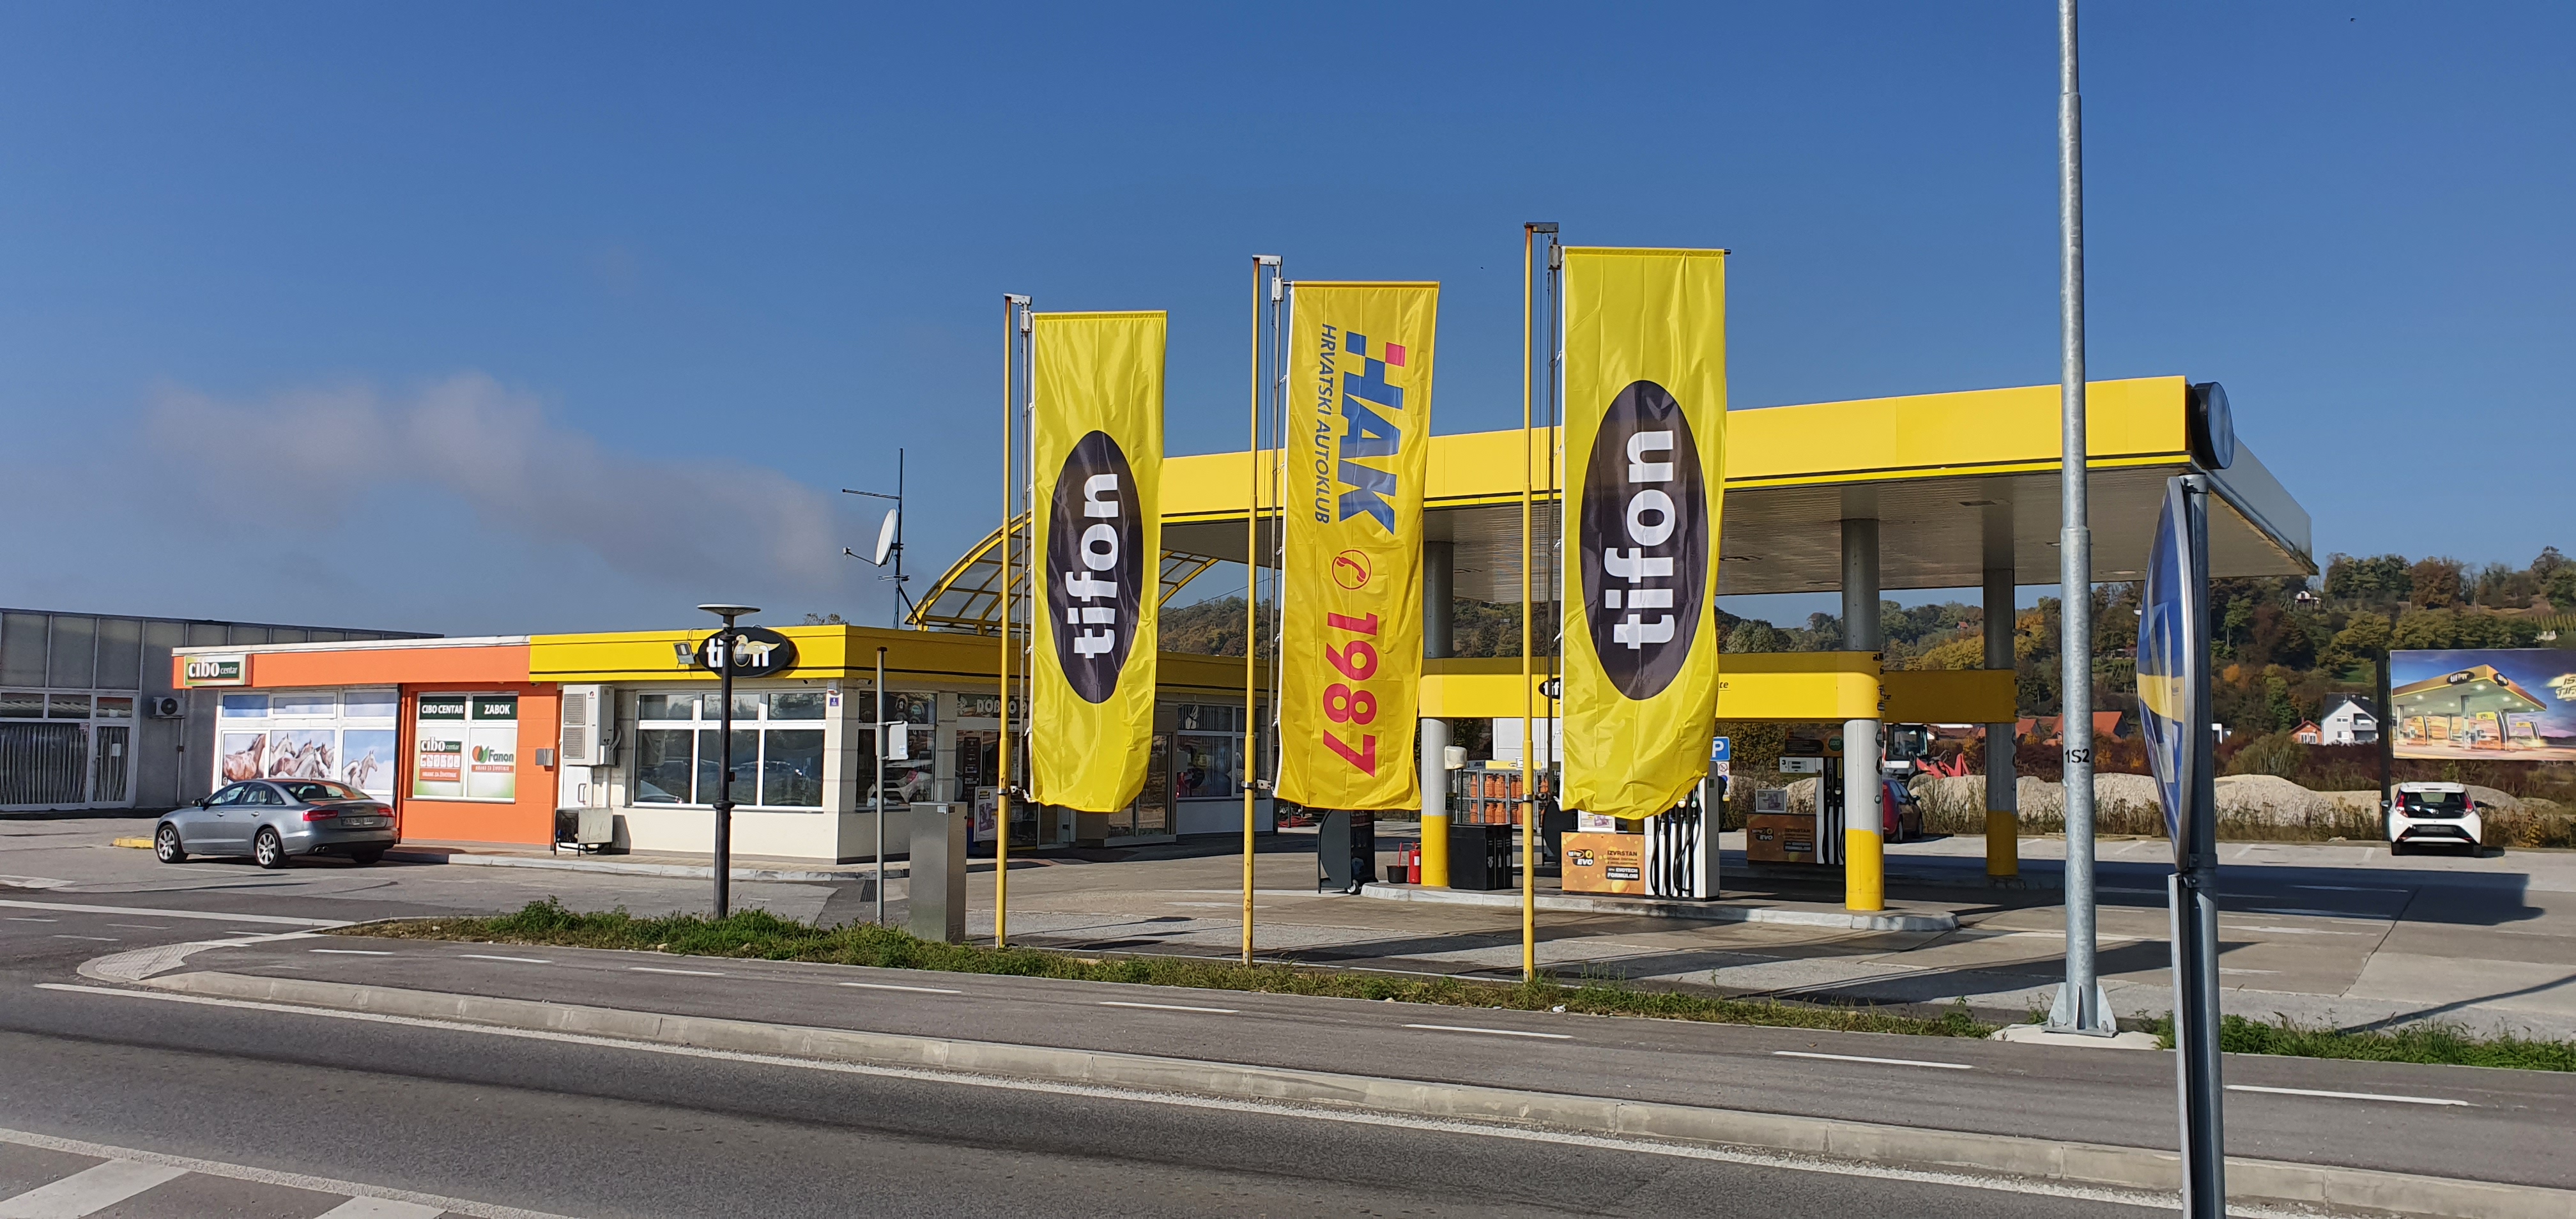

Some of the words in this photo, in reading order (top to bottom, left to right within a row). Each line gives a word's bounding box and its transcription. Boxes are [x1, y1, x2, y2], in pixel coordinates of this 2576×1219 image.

[1317, 323, 1337, 415] HRVATSKI
[1337, 331, 1406, 535] HAK
[1315, 418, 1331, 524] AUTOKLUB
[1604, 430, 1675, 650] tifon
[1066, 473, 1119, 659] tifon
[188, 657, 220, 677] cibo
[1322, 612, 1377, 778] 1987
[422, 704, 437, 714] CIBO
[438, 705, 464, 714] CENTAR
[484, 704, 510, 714] ZABOK
[976, 699, 1017, 714] DOBO
[421, 737, 445, 751] cibo
[1712, 740, 1724, 758] P
[488, 749, 514, 762] Fanon
[2066, 748, 2090, 763] 1S2
